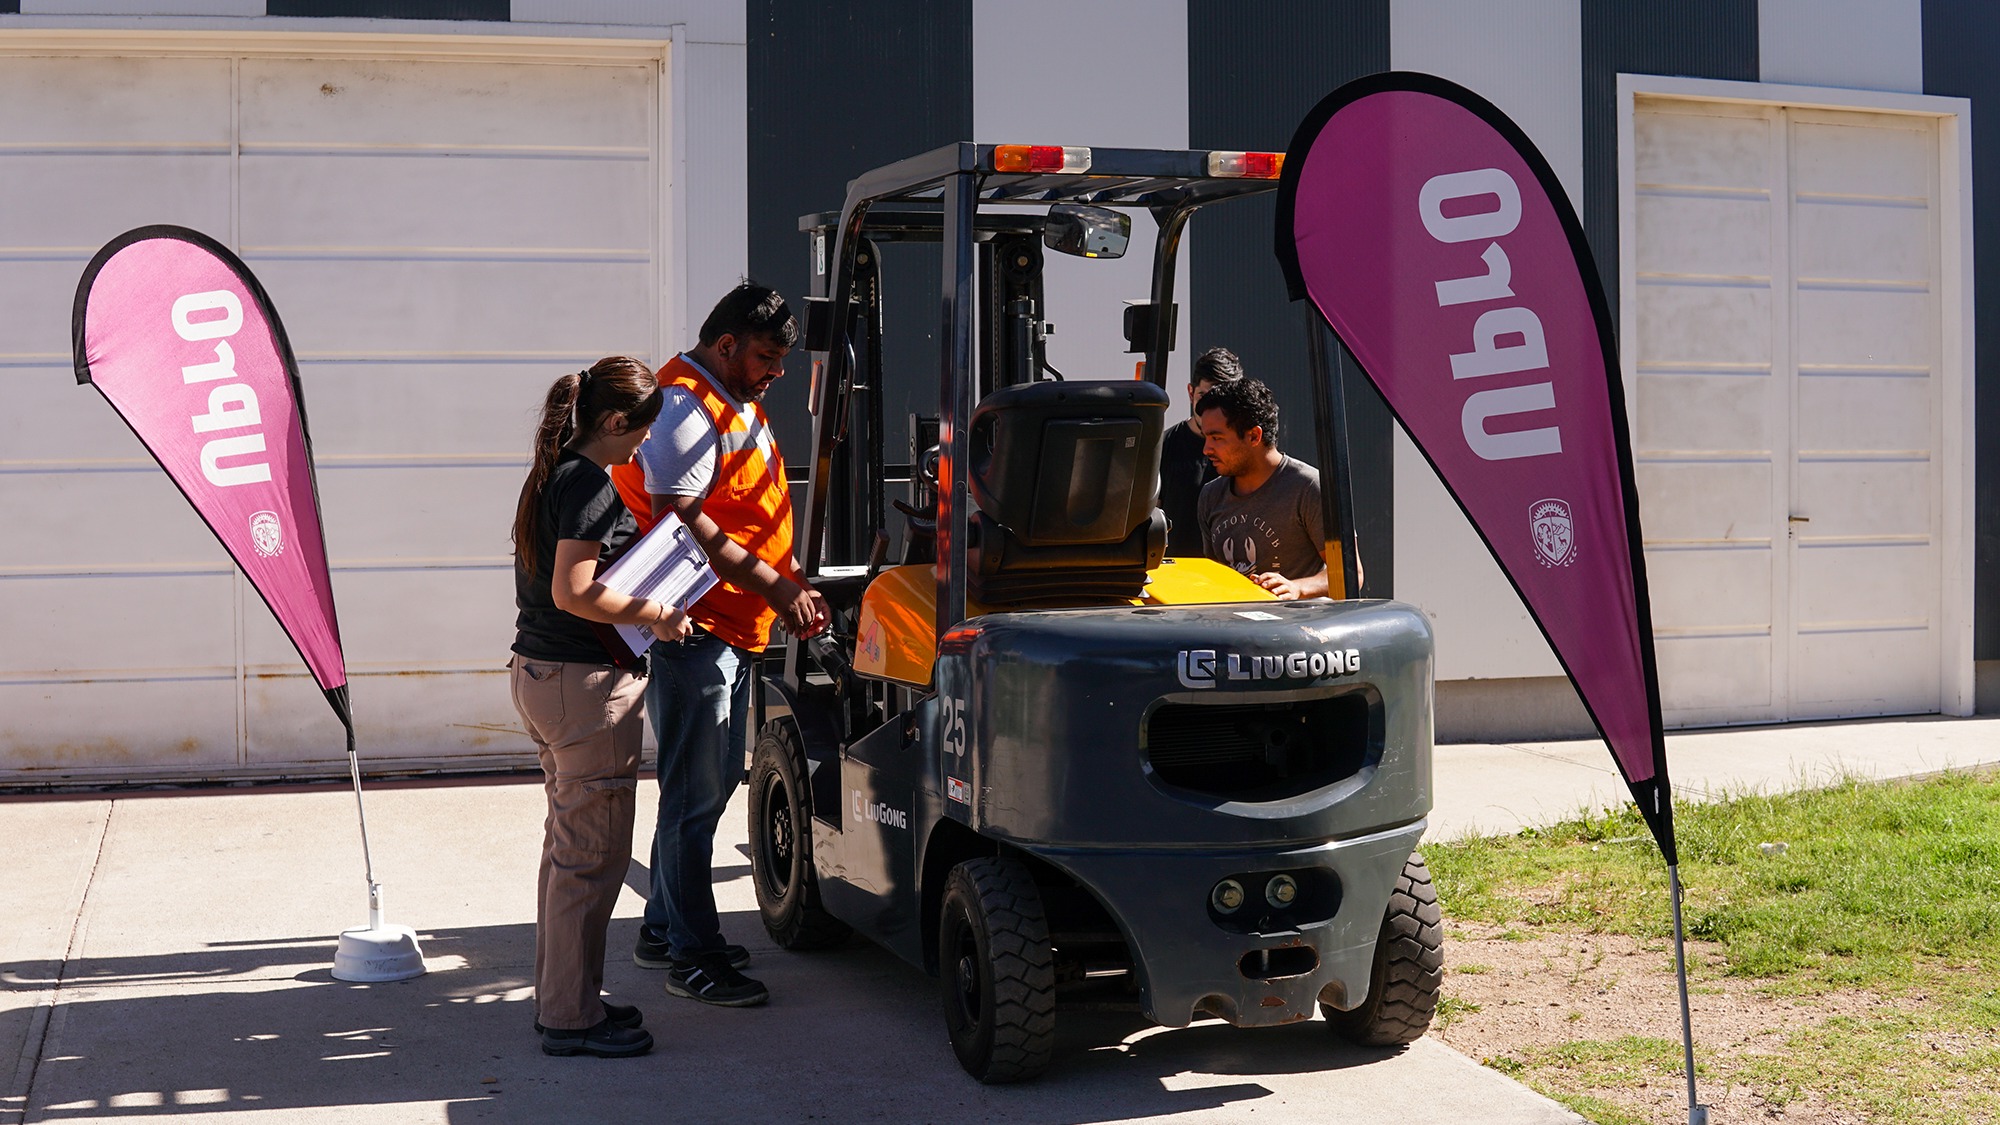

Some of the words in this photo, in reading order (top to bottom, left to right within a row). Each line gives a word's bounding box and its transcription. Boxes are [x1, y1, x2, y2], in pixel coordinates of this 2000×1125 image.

[1211, 514, 1248, 543] OTTON
[1253, 517, 1280, 548] CLUB
[1227, 648, 1362, 681] LIUGONG
[943, 695, 966, 758] 25
